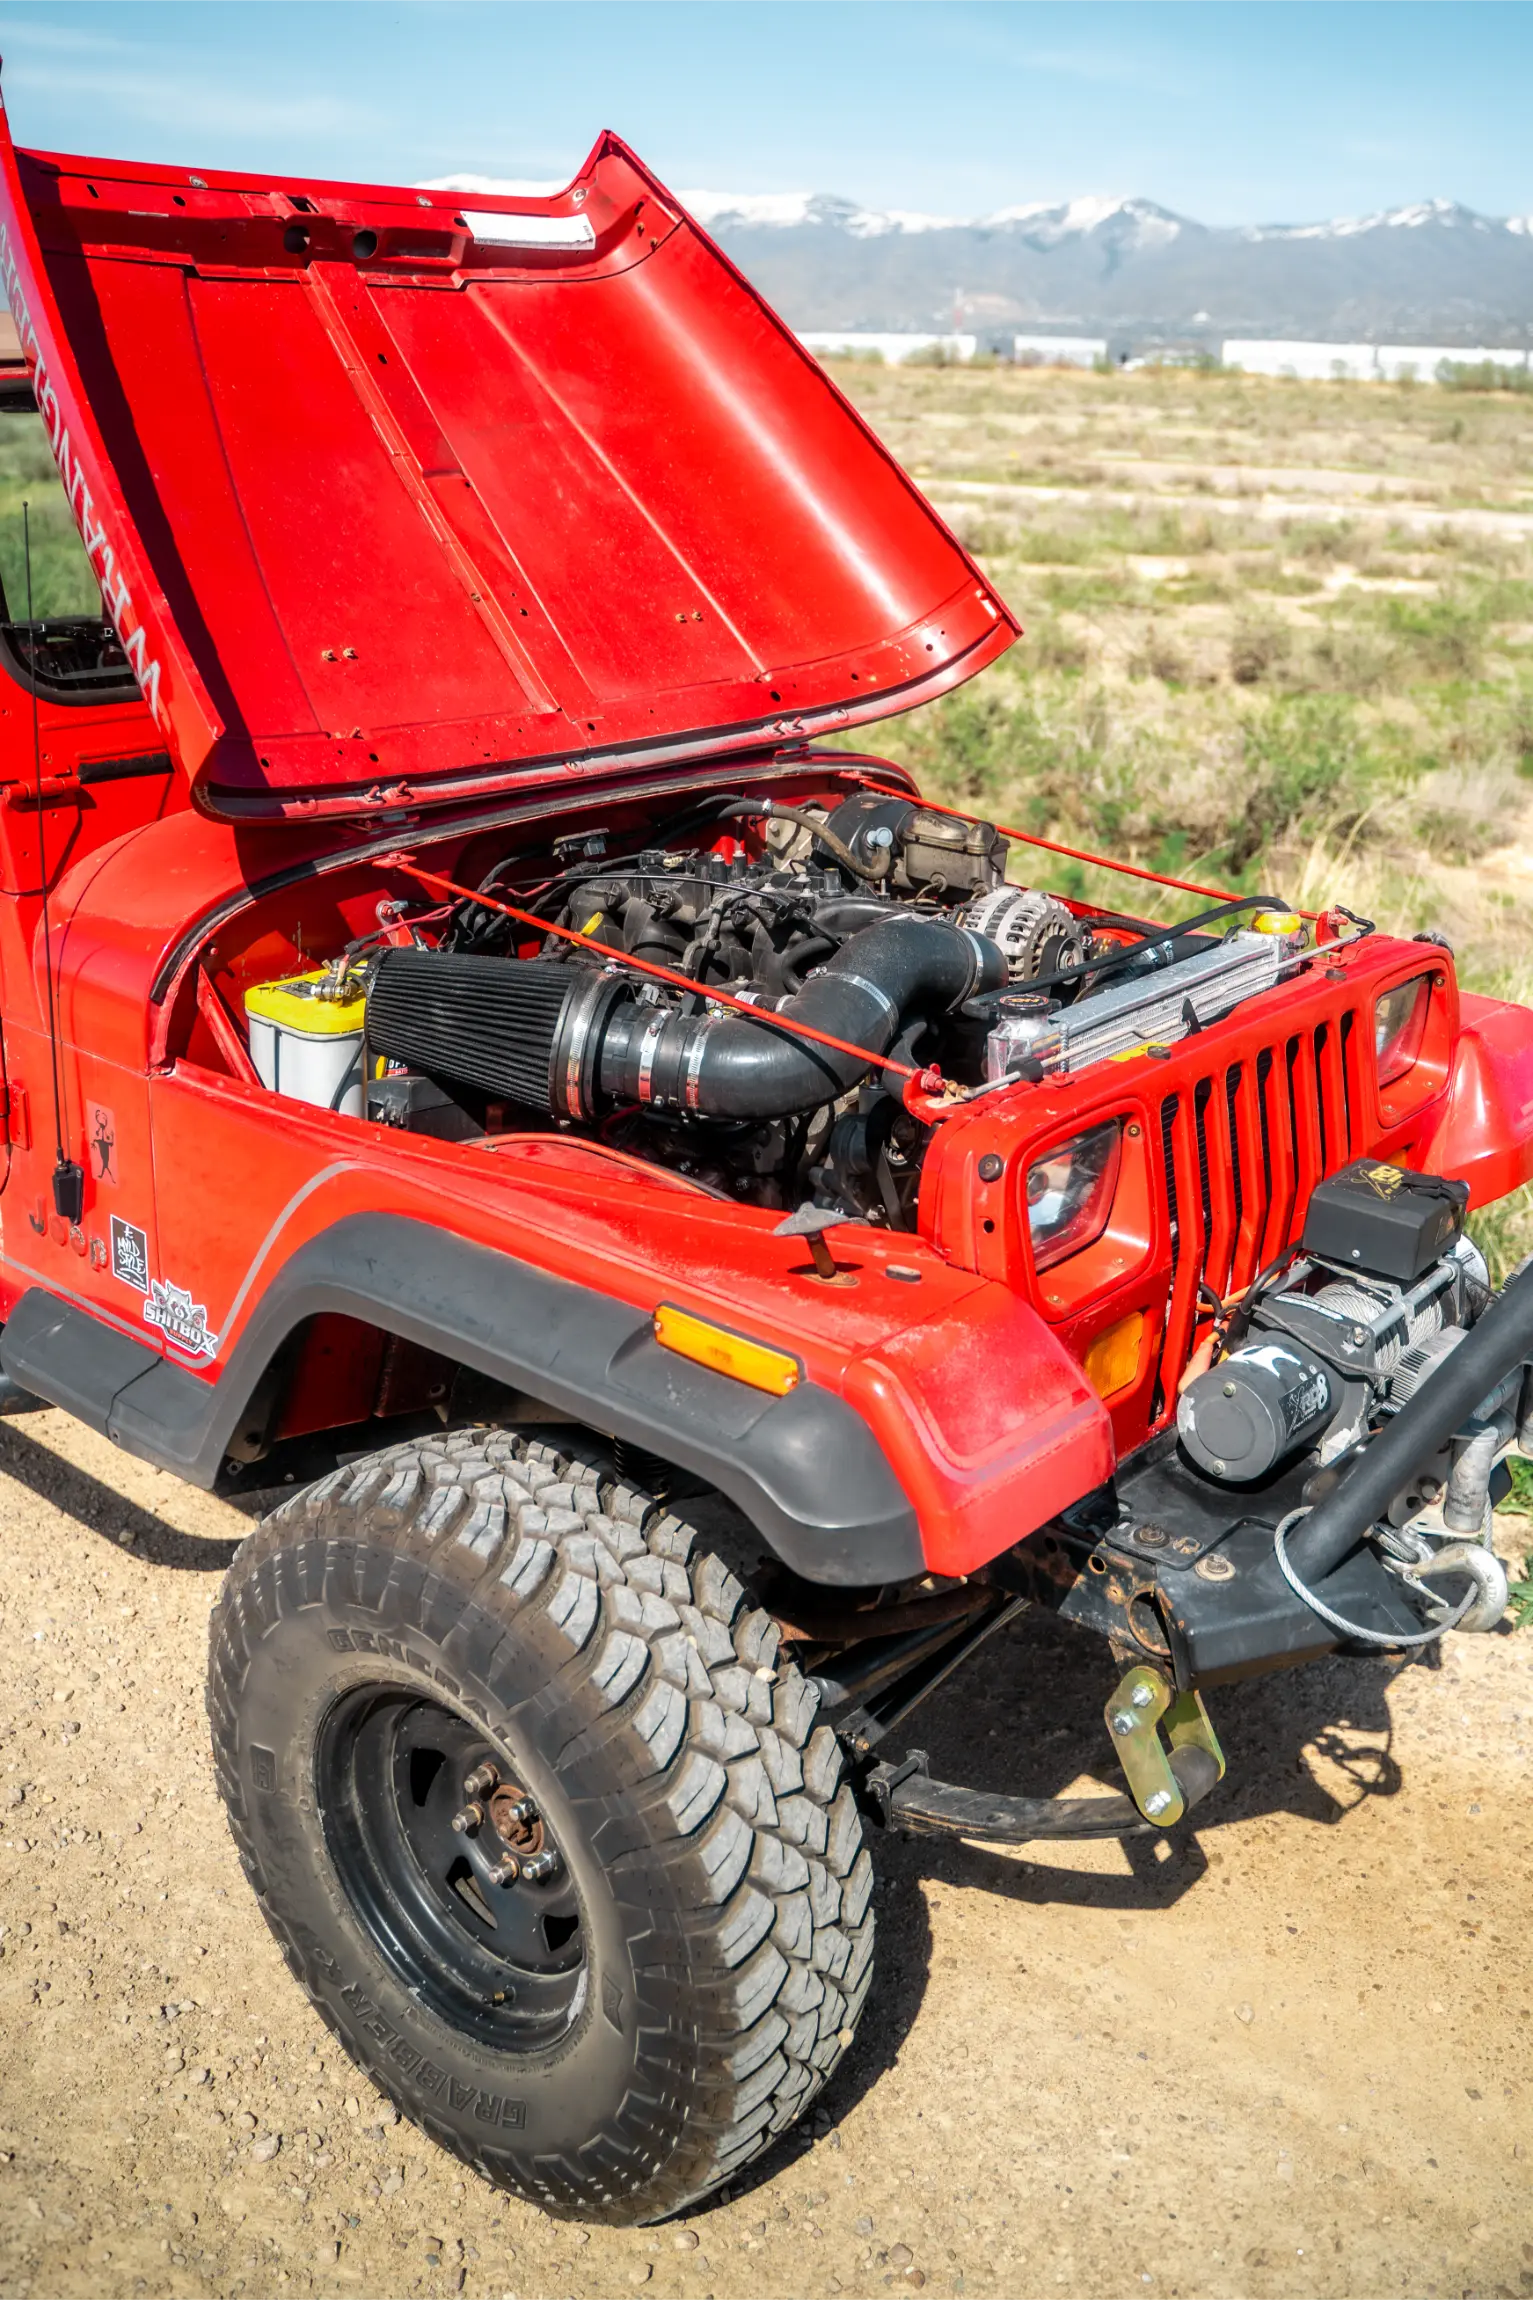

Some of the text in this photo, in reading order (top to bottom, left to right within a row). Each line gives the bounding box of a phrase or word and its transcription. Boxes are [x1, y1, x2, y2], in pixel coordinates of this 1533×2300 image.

[0, 222, 162, 733] WRANGLER
[144, 1301, 217, 1355] SHITBOX
[168, 1328, 194, 1346] SUPPLY
[327, 1628, 517, 1759] GENERAL
[340, 1981, 528, 2130] GRABBER
